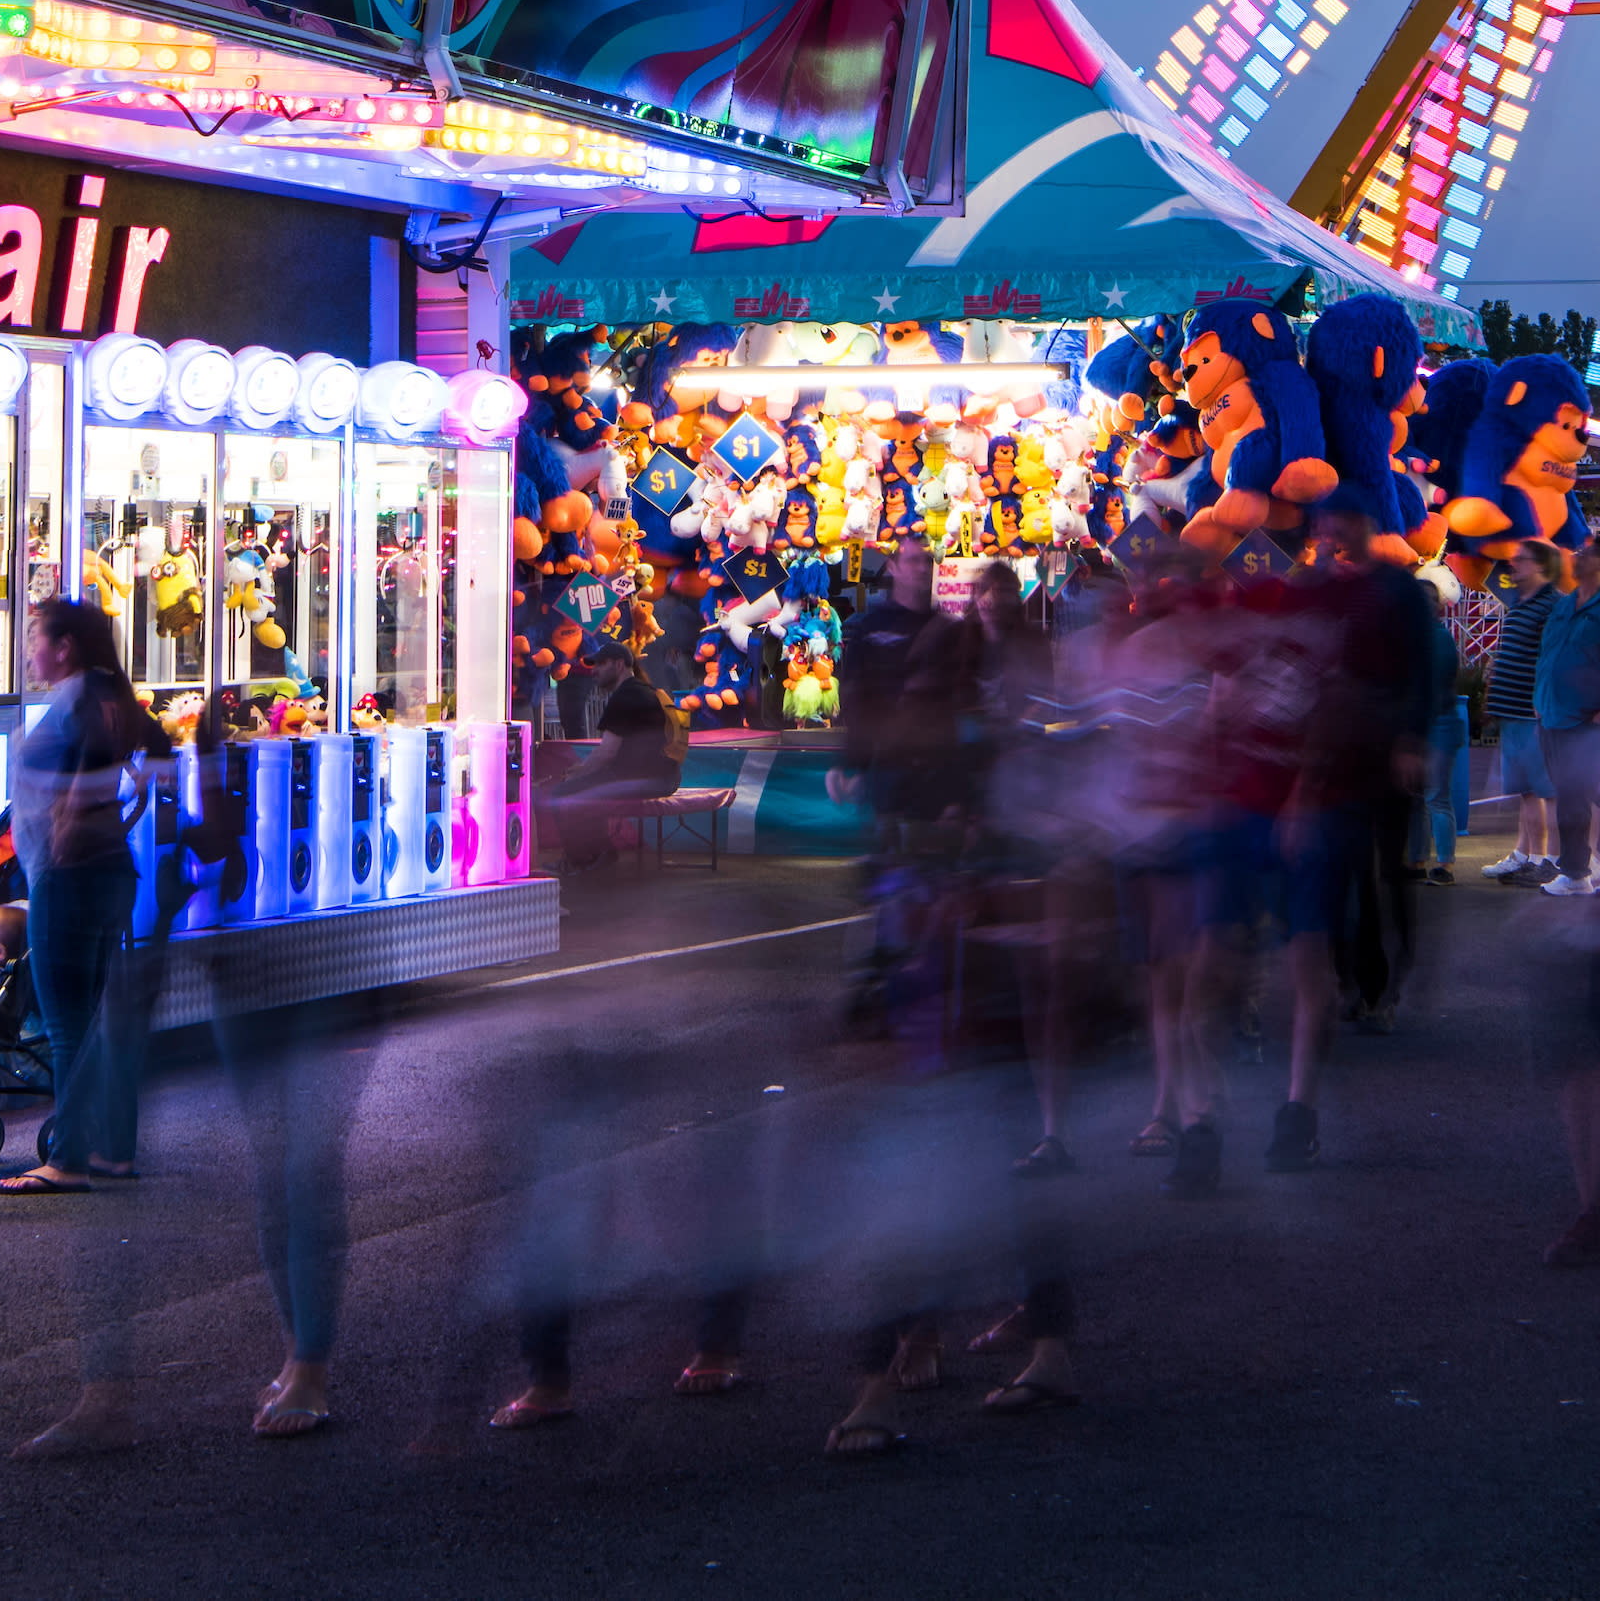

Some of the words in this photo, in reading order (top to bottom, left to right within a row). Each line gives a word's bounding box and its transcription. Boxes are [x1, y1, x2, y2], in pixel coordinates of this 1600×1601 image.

[732, 435, 761, 460] $1
[650, 468, 677, 494] $1
[607, 509, 625, 519] WIN
[610, 500, 626, 510] 4TH
[743, 559, 768, 578] $1
[1243, 552, 1271, 576] $1
[617, 579, 632, 588] 1ST
